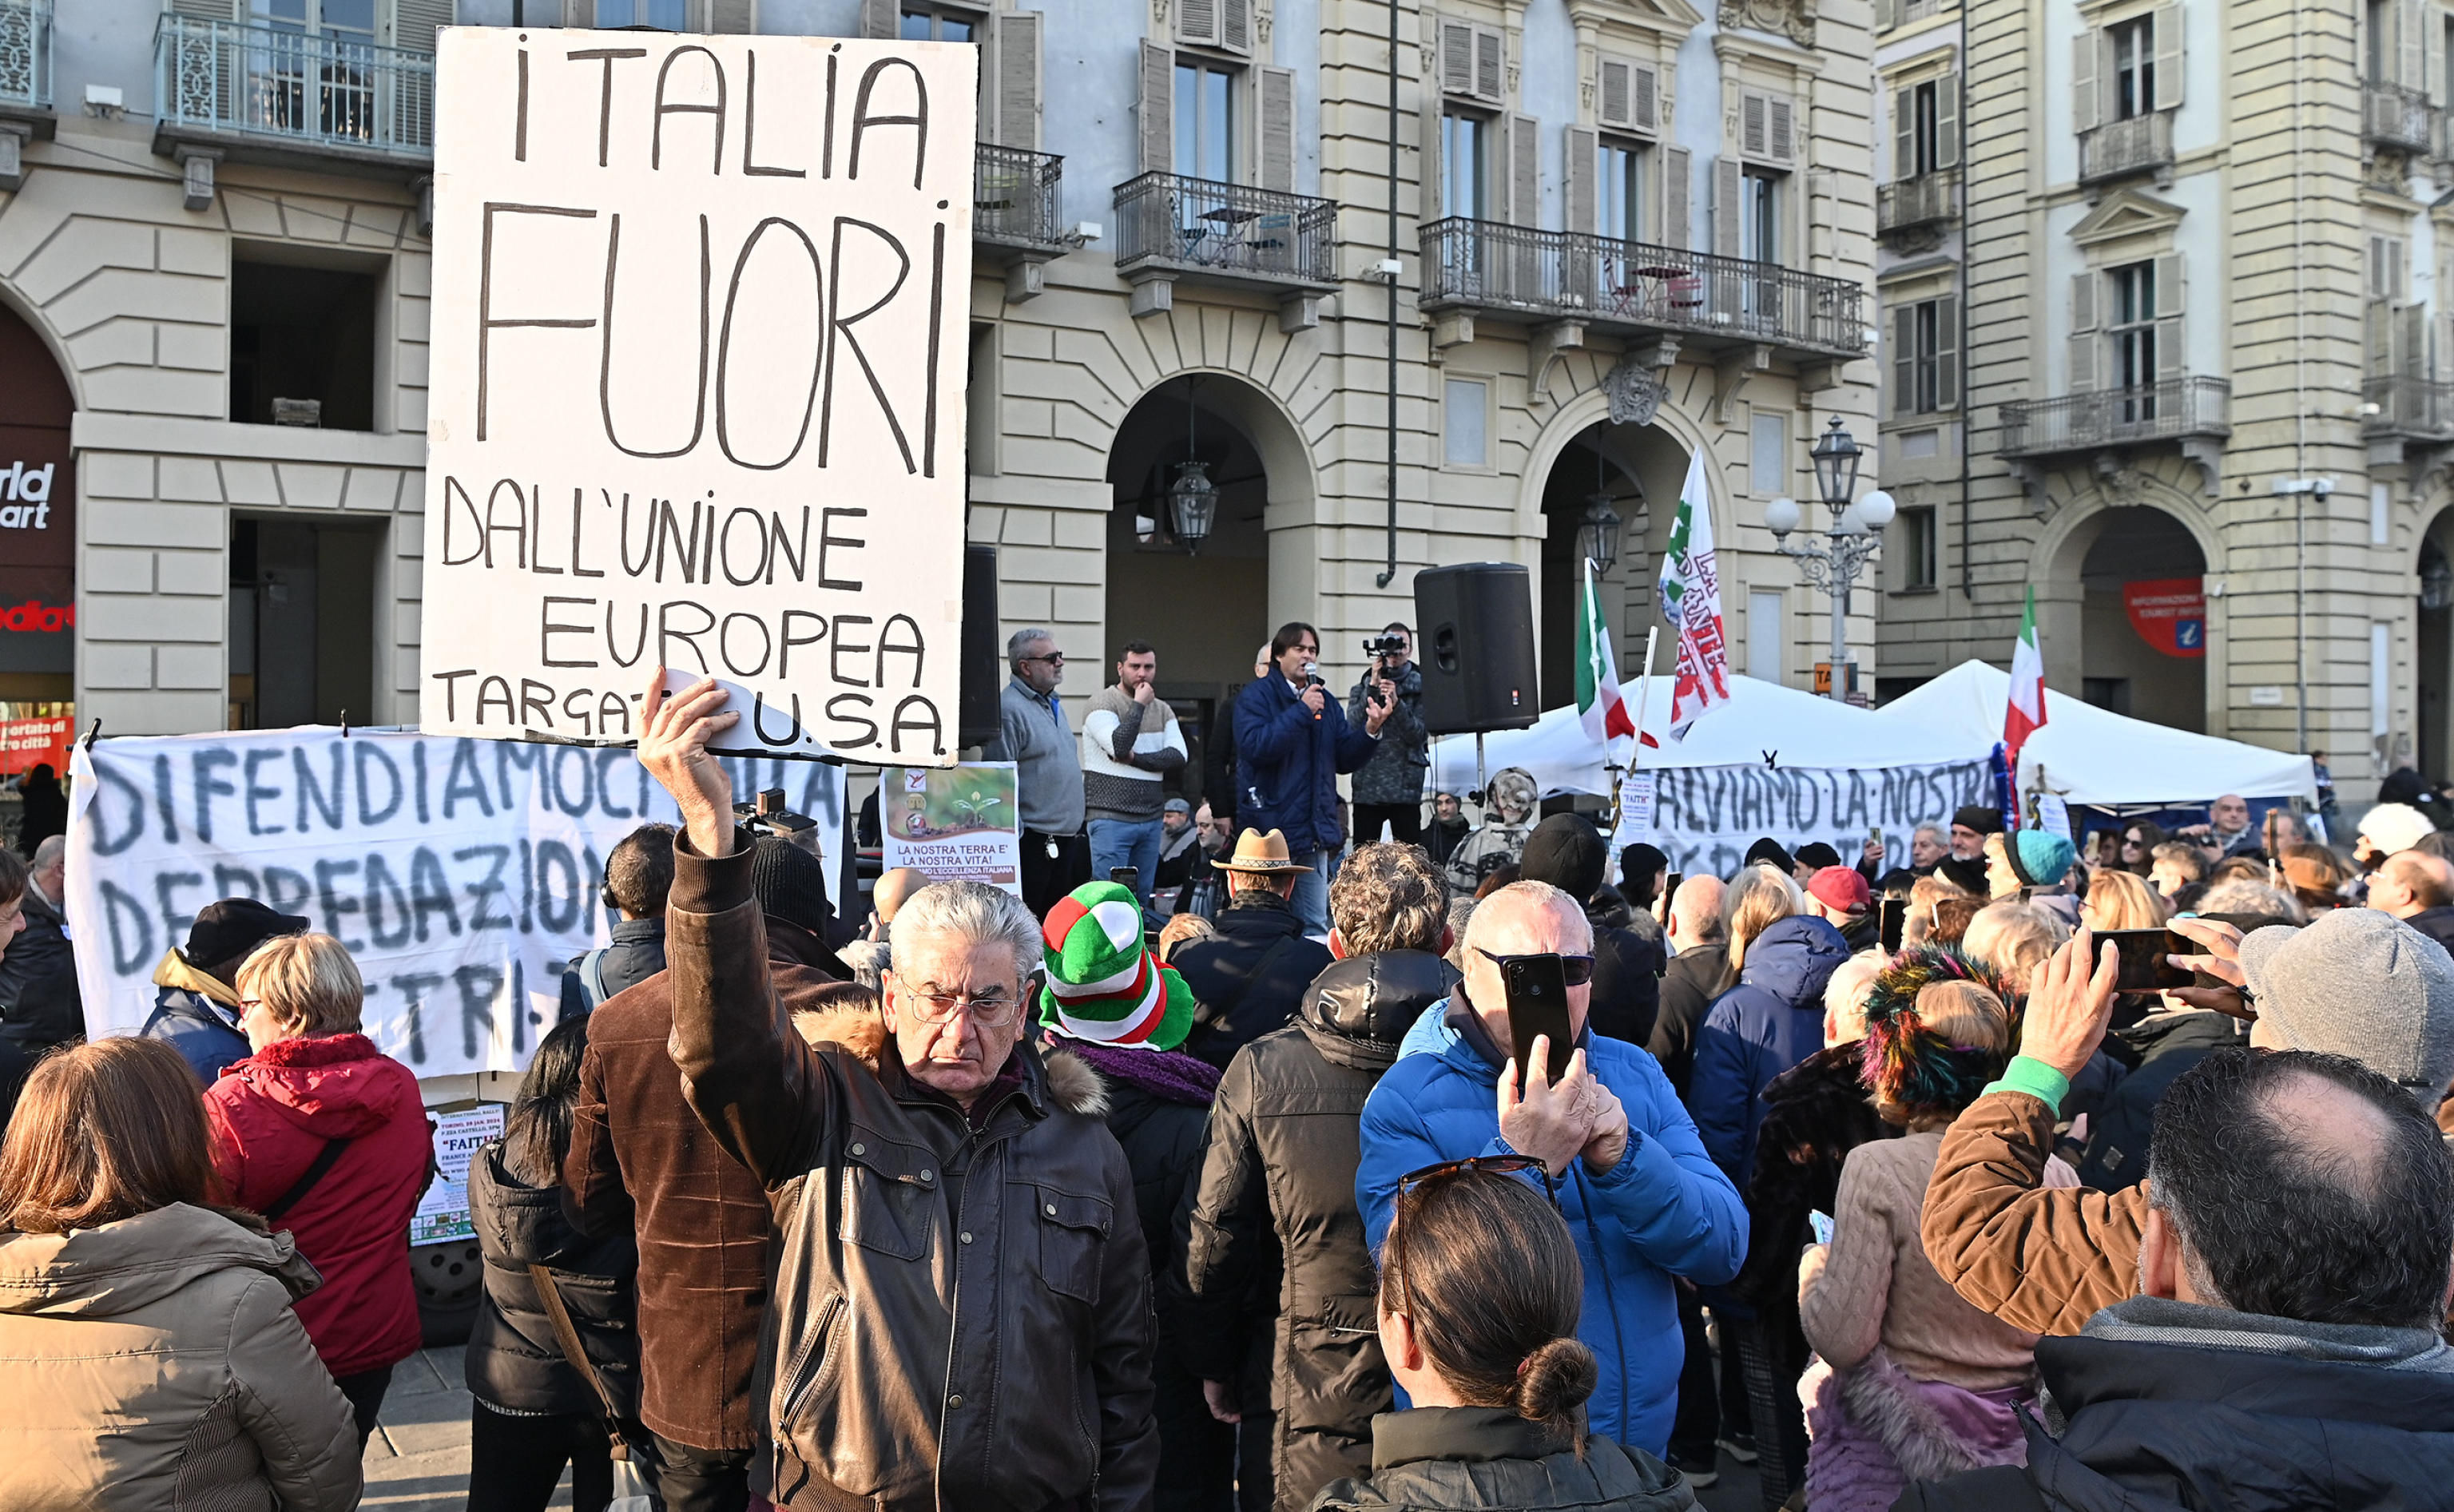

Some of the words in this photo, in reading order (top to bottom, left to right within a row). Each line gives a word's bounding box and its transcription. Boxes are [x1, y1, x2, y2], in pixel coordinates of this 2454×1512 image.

[542, 596, 926, 689] EUROPEA
[1681, 585, 1727, 677] ANTE
[1816, 671, 1831, 684] TA
[432, 669, 674, 736] TARGA
[752, 691, 947, 756] U.S.A.
[1650, 767, 1818, 833] ALVIAMO
[898, 846, 911, 855] LA
[914, 845, 957, 855] NOSTRA
[959, 845, 996, 854] TERRA
[999, 844, 1008, 853] E'
[903, 856, 916, 866] LA
[919, 855, 962, 865] NOSTRA
[965, 855, 992, 864] VITA!
